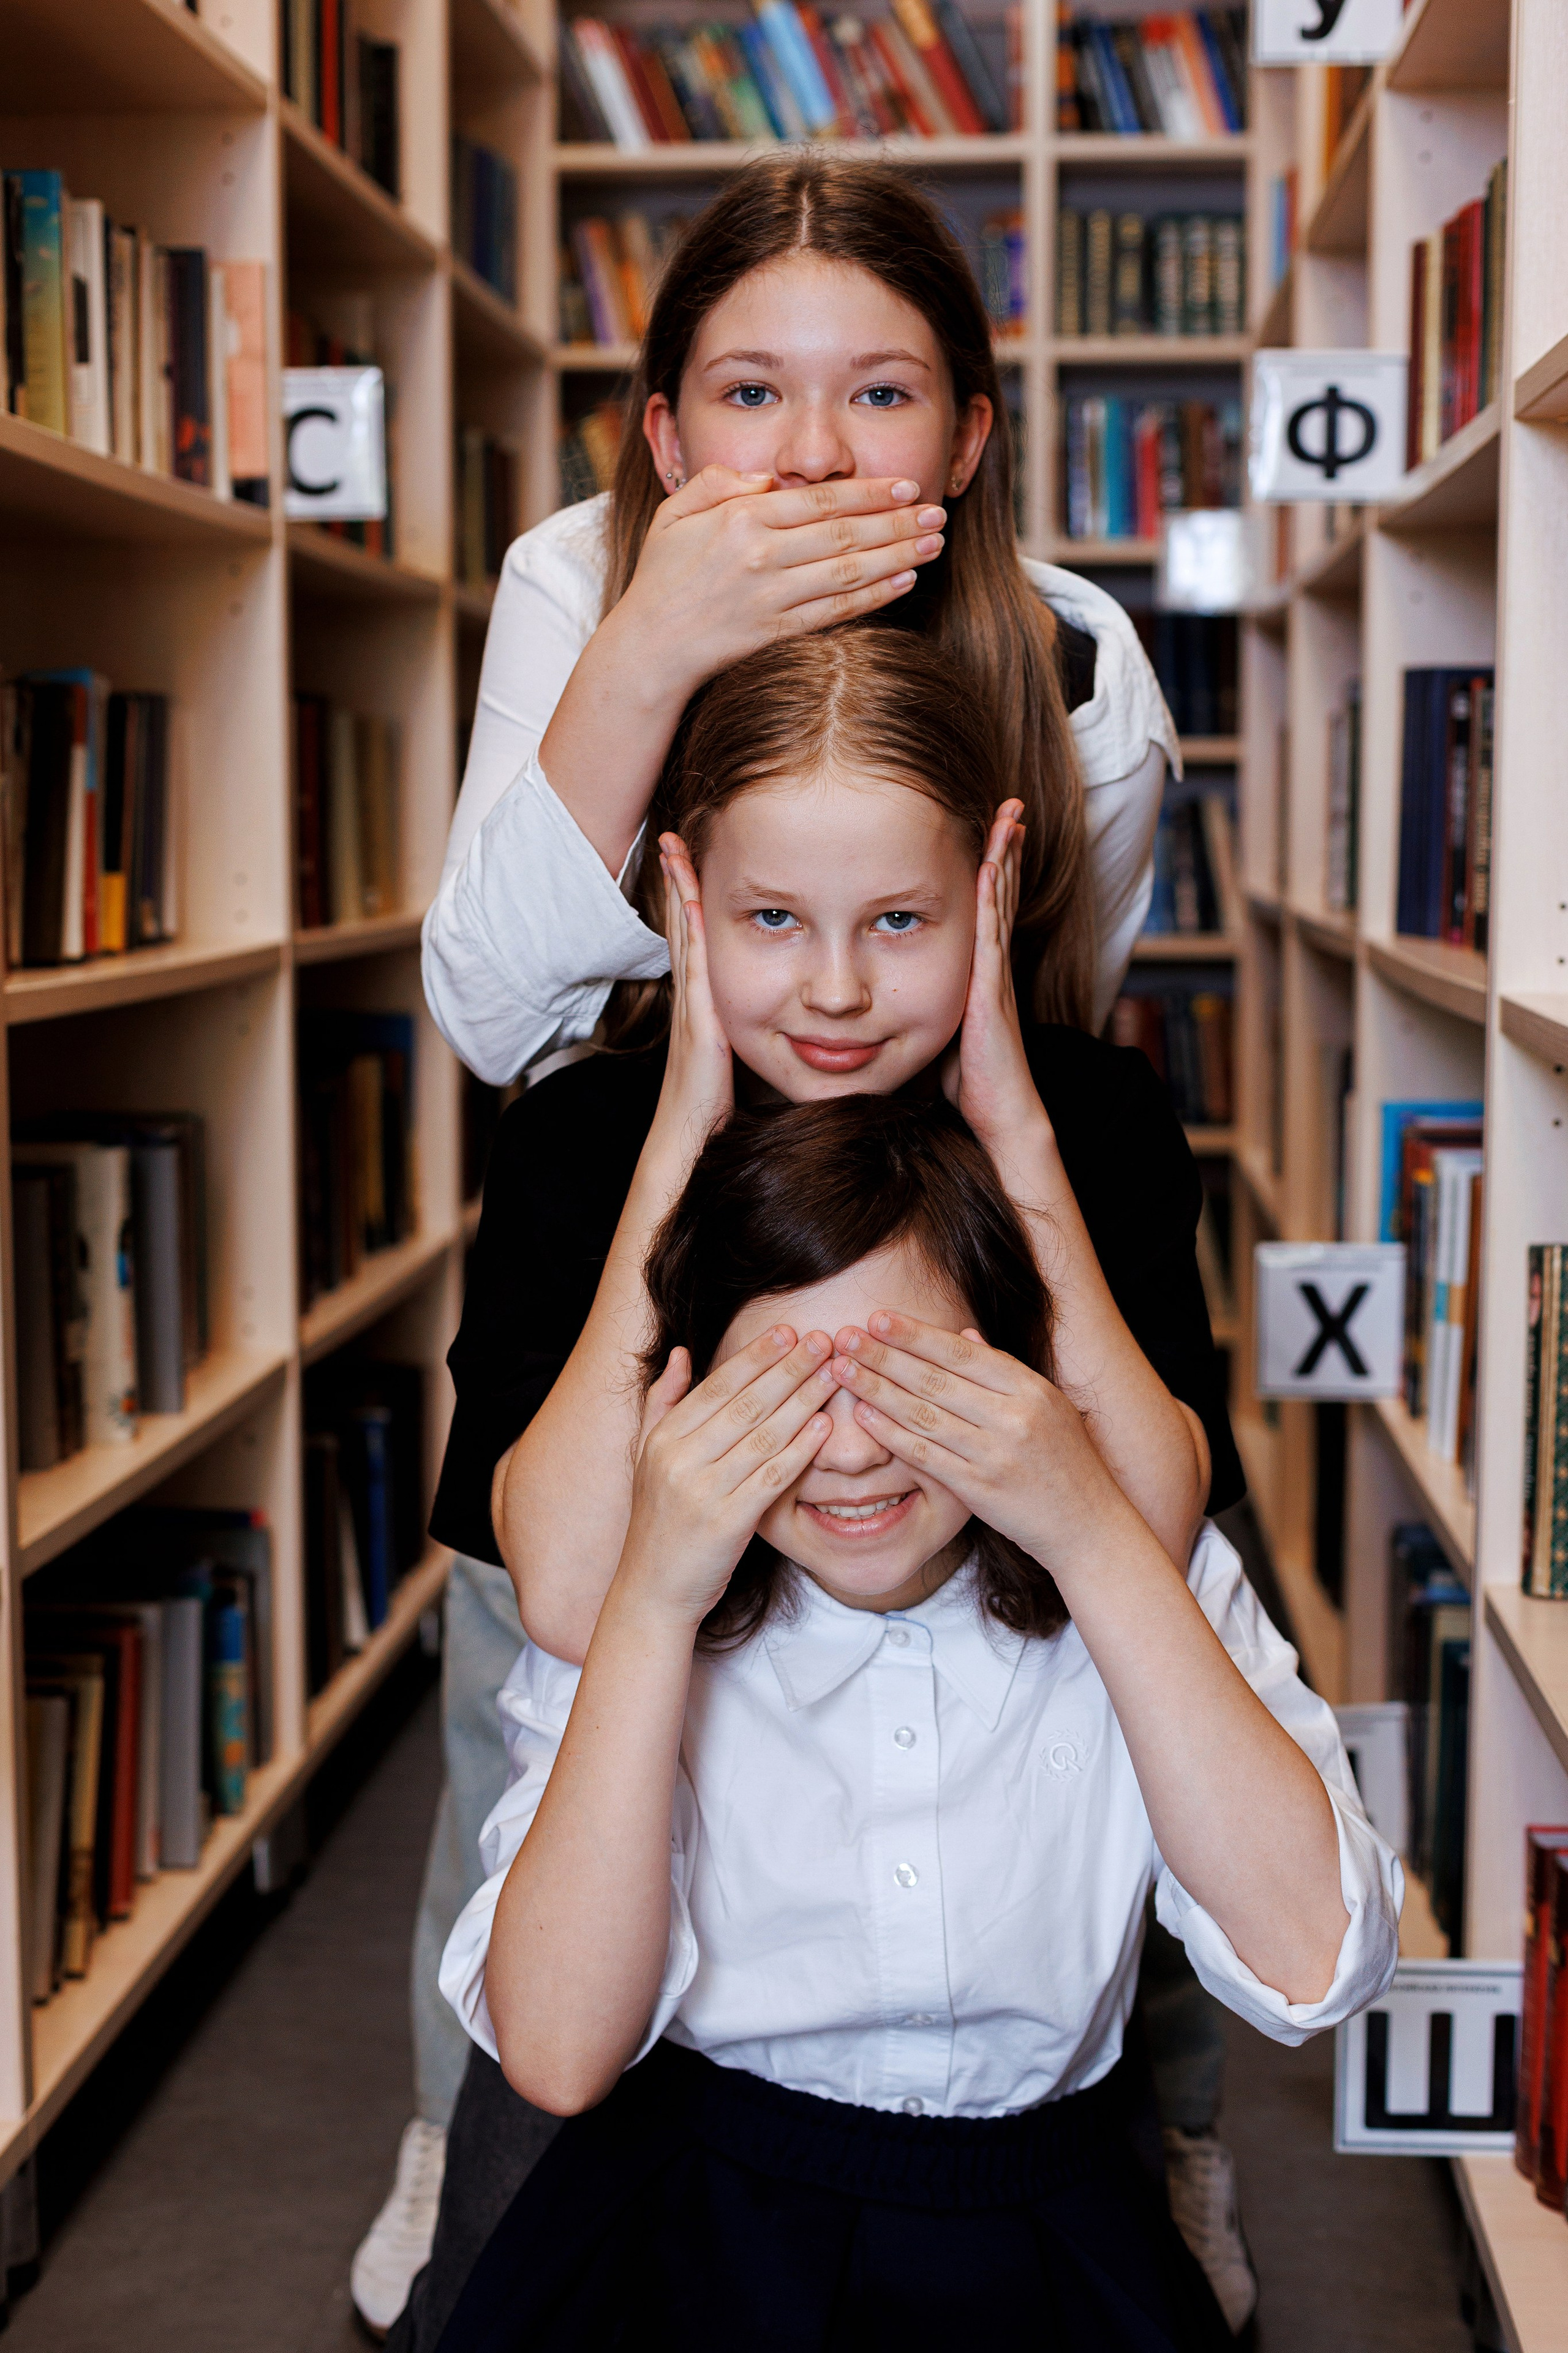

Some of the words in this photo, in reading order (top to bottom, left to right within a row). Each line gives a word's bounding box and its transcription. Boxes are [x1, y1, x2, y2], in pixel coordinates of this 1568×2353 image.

[287, 406, 339, 496] С
[1287, 385, 1377, 480] Ф
[1295, 1282, 1369, 1377] Х
